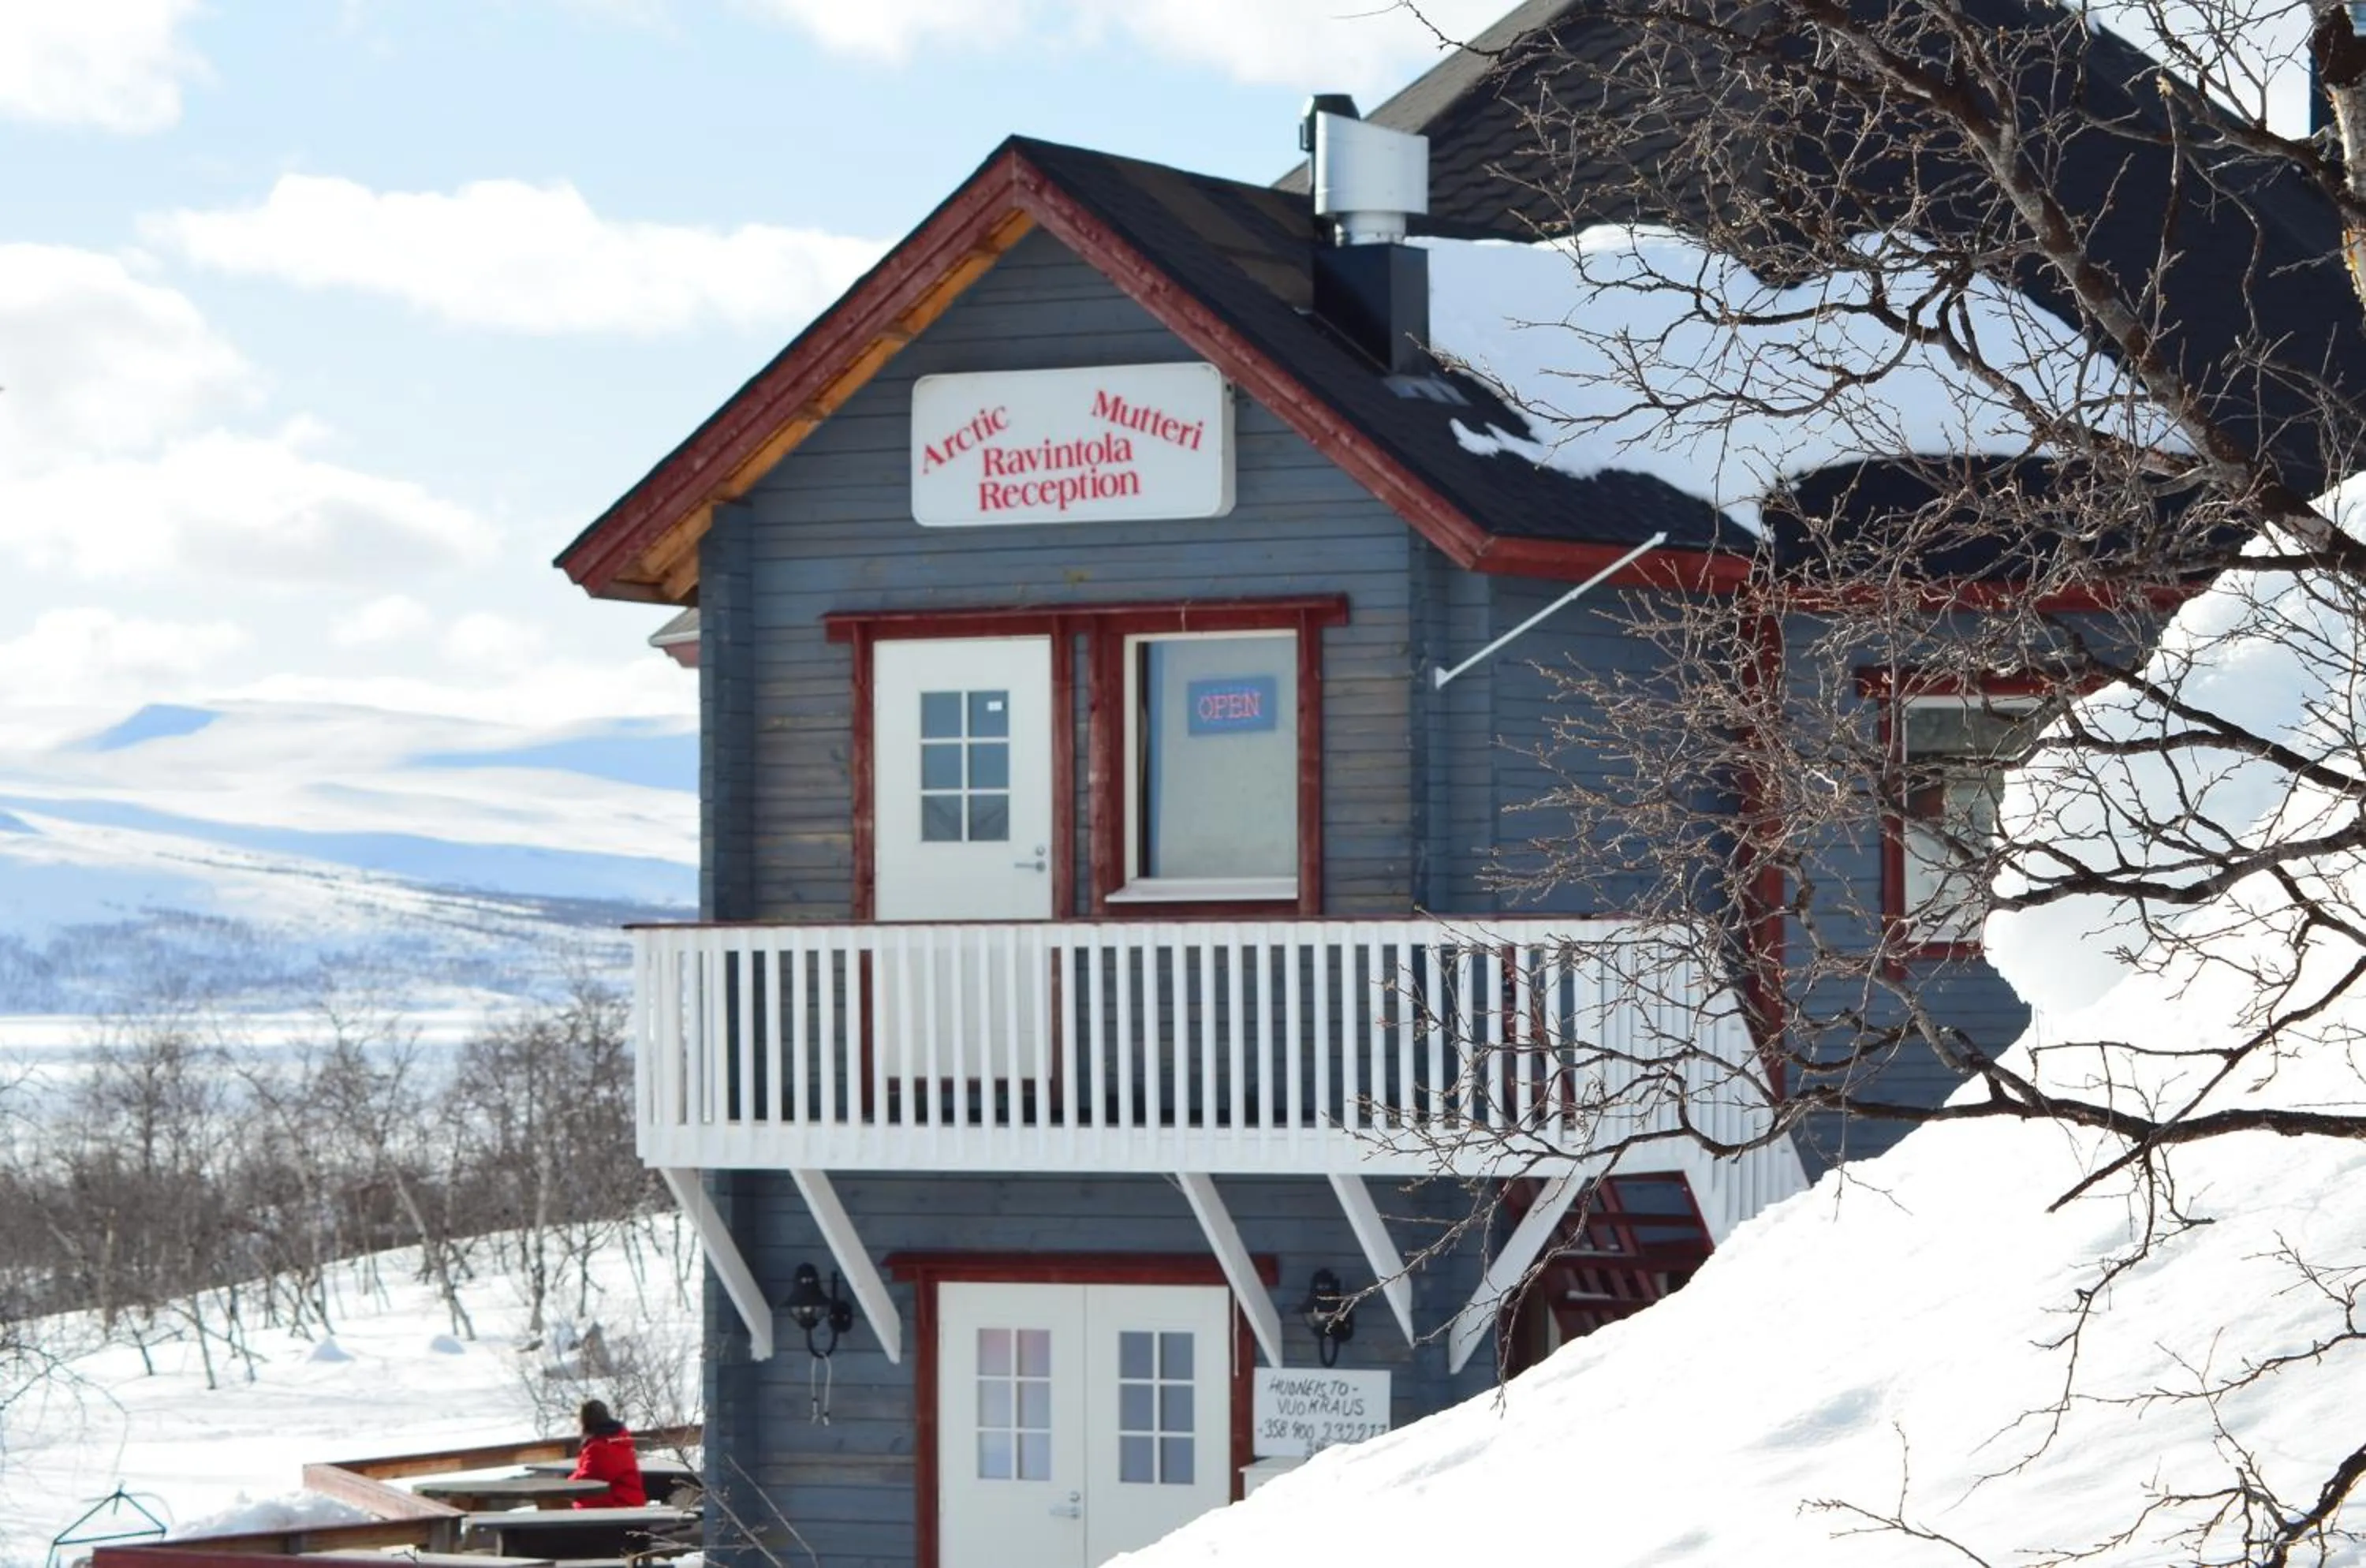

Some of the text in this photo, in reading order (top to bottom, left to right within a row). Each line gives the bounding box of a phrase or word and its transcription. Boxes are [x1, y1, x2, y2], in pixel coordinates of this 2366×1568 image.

[922, 390, 1205, 475] Arctic Mutteri
[983, 433, 1133, 478] Ravintola
[978, 468, 1140, 513] Reception
[1198, 692, 1262, 722] OPEN
